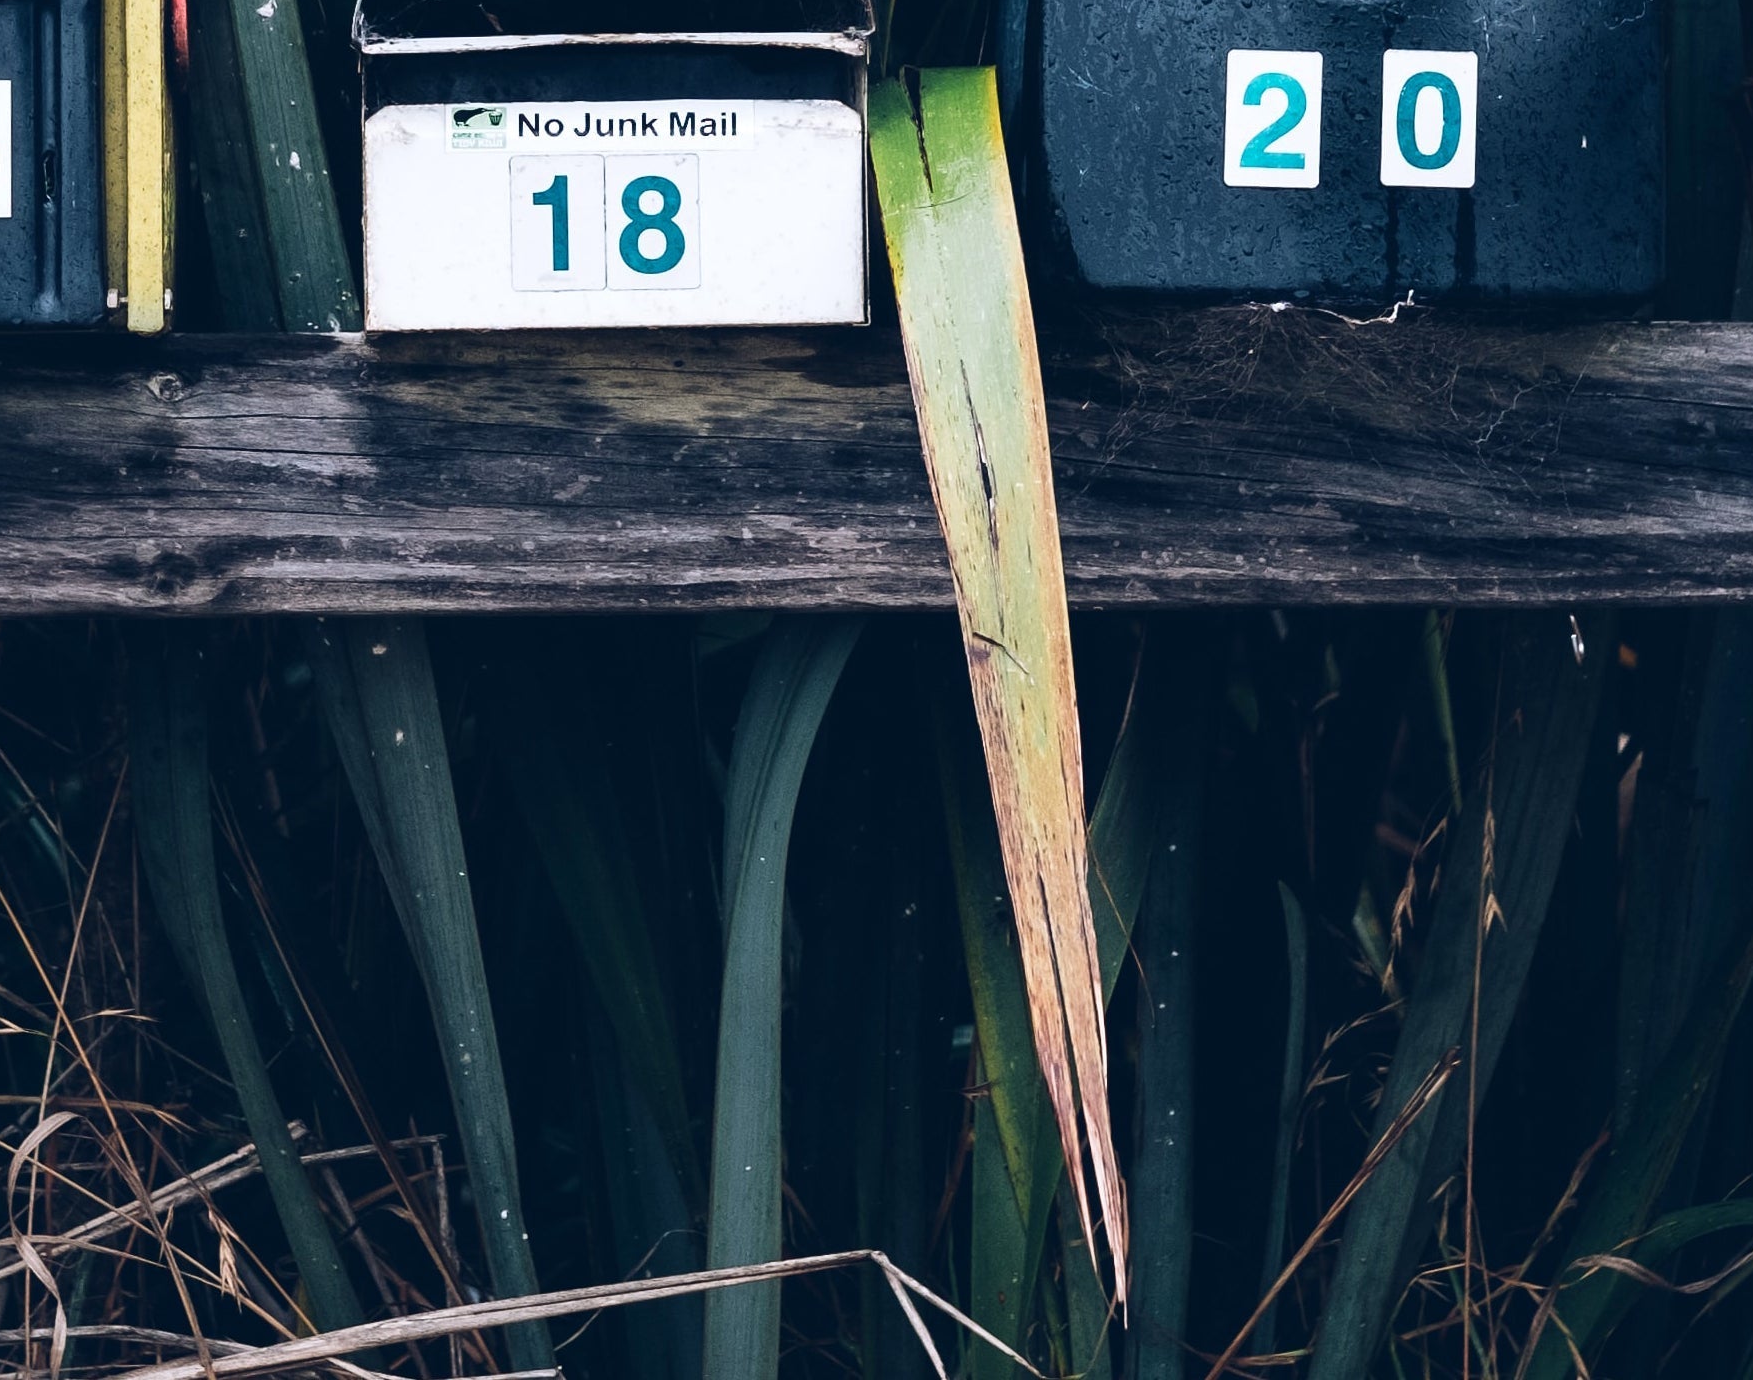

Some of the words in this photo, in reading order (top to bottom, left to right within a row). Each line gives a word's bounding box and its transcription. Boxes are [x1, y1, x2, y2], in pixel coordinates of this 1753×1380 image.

[518, 113, 564, 138] No
[573, 112, 658, 138] Junk
[669, 111, 738, 137] Mail
[532, 174, 686, 275] 18
